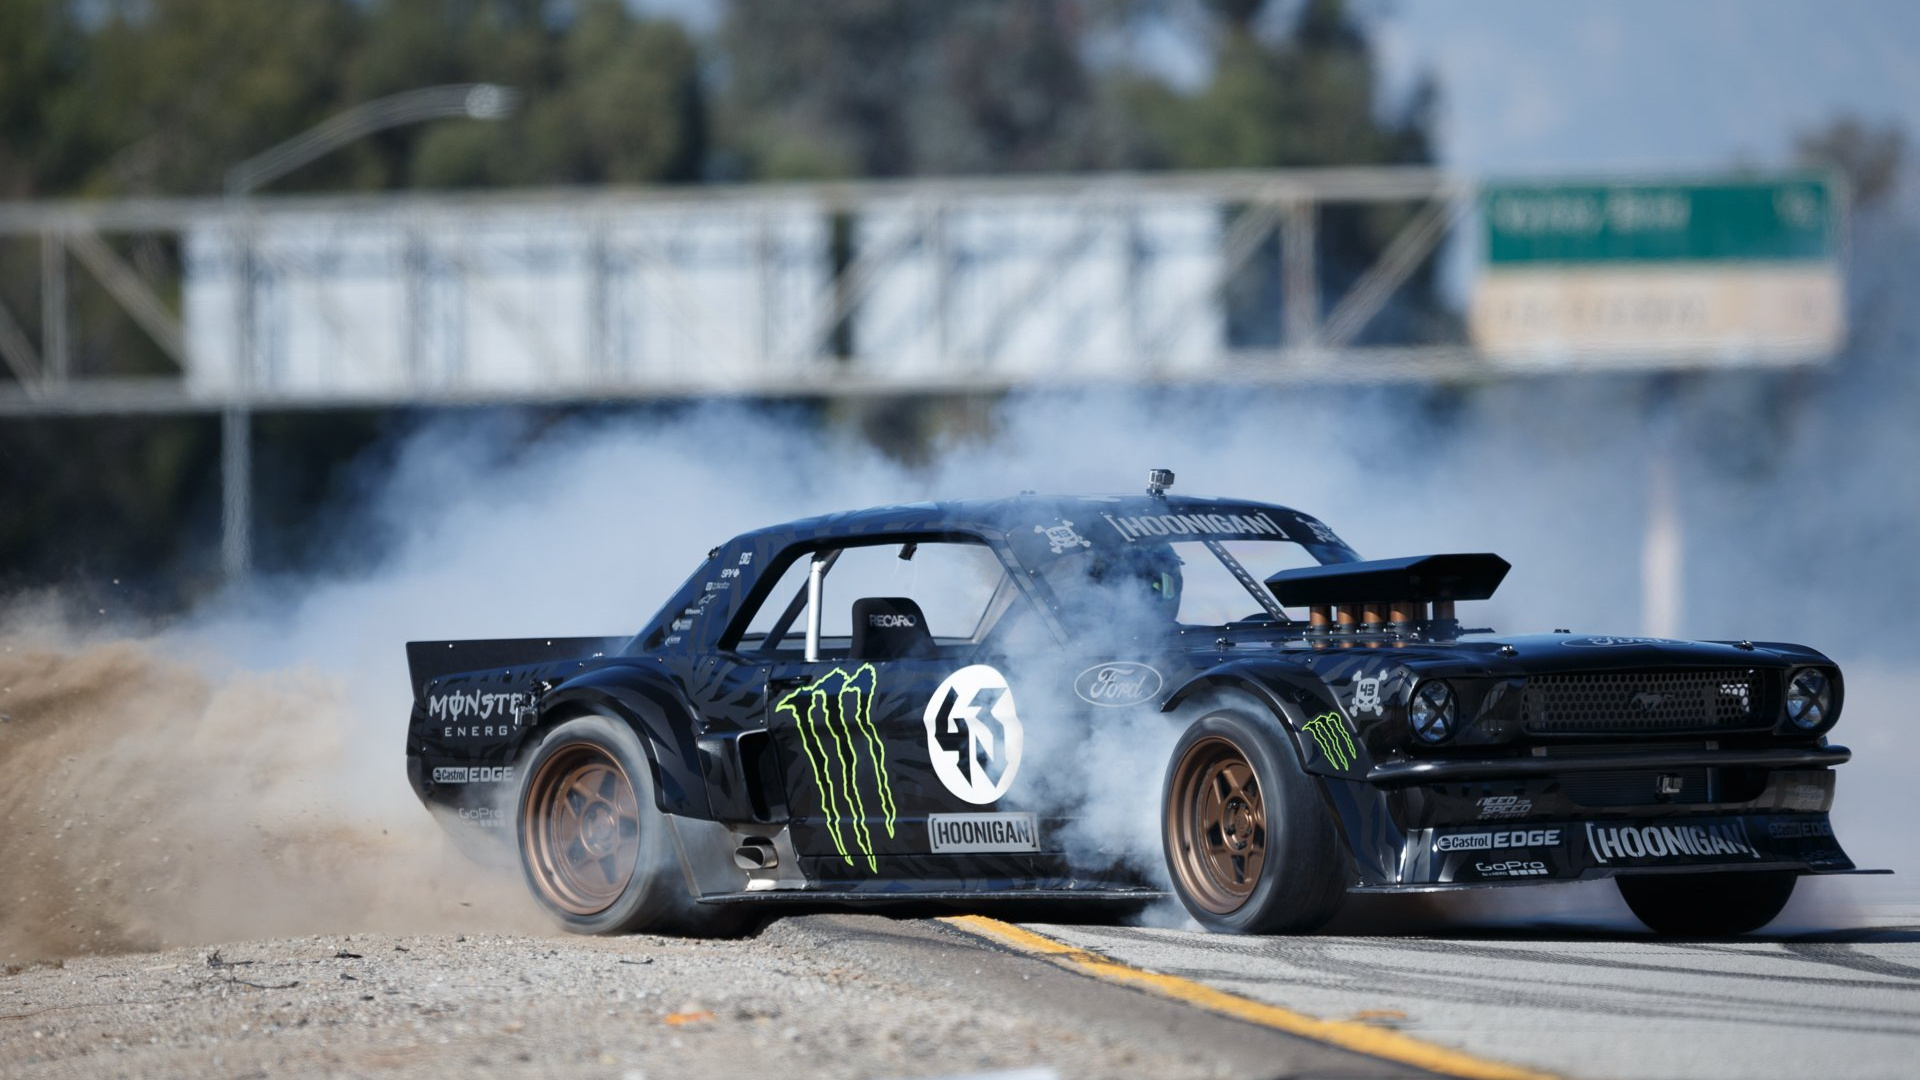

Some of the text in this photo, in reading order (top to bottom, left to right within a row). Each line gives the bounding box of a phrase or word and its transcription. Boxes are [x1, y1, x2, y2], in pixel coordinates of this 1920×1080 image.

[1050, 529, 1072, 539] 43
[869, 614, 917, 627] RECARO
[1089, 667, 1144, 700] Ford
[1359, 683, 1376, 696] 43
[444, 725, 517, 737] ENERG
[934, 685, 1009, 788] 43
[441, 767, 514, 782] Castrol EDGE
[1476, 796, 1518, 806] NEED
[458, 807, 504, 819] GoPro
[1481, 804, 1533, 815] SPEED
[1451, 829, 1560, 849] Castrol EDGE
[1475, 861, 1545, 872] GoPro
